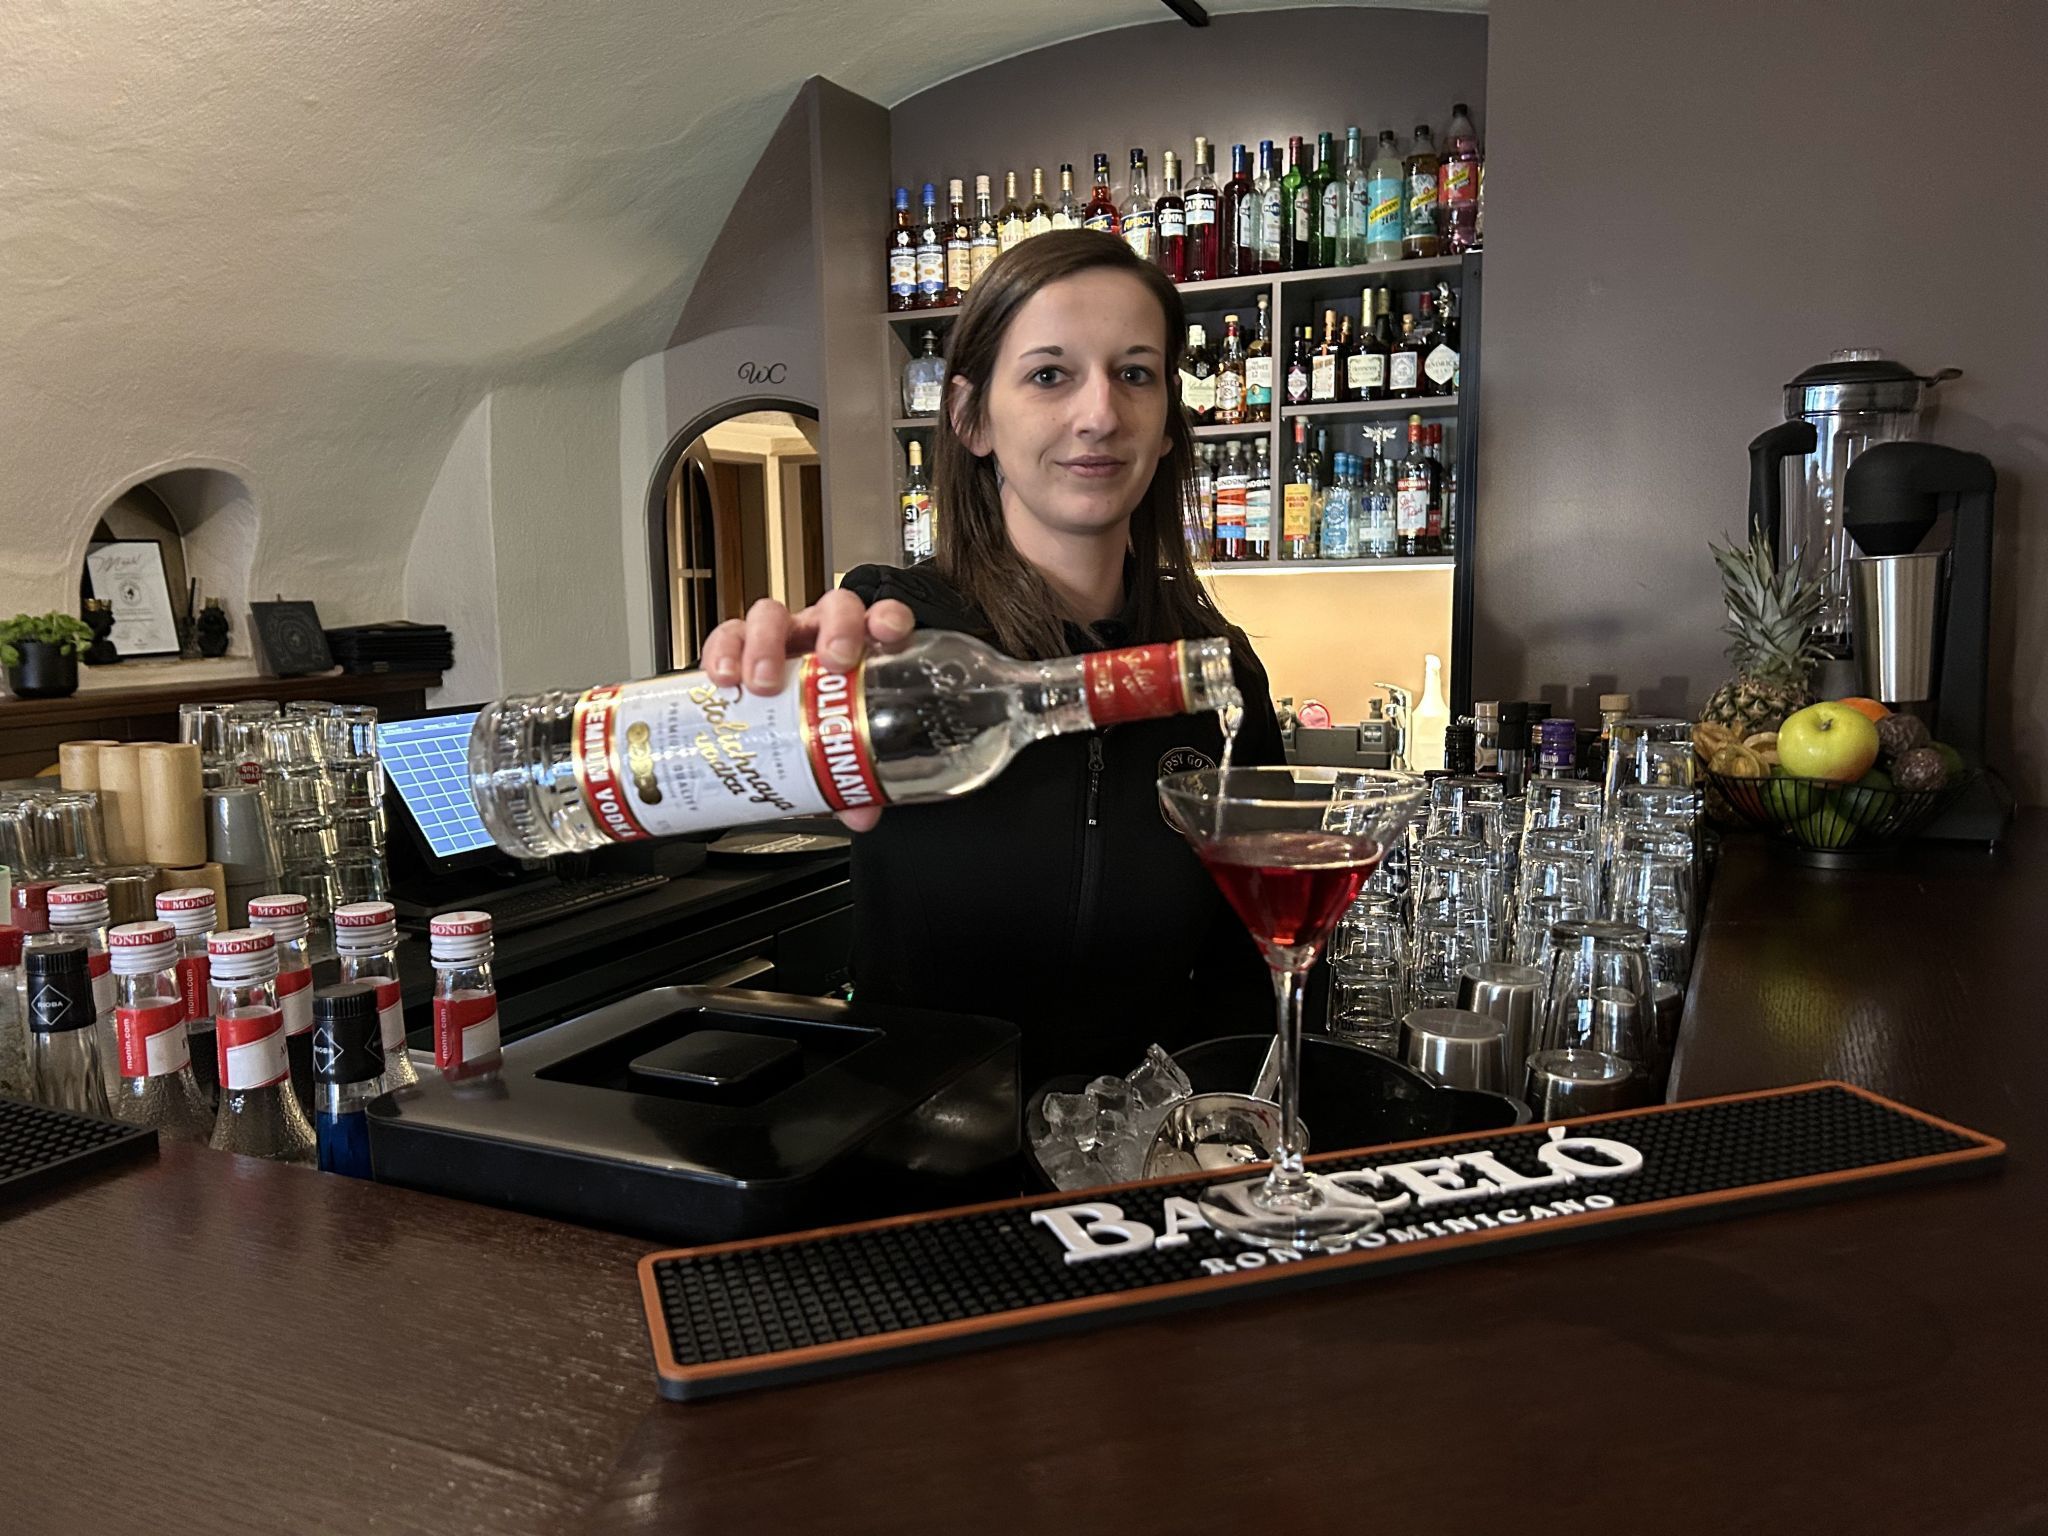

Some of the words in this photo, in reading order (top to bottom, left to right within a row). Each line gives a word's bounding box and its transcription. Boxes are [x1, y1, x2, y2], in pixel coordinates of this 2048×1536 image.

[738, 362, 787, 384] WC
[905, 508, 918, 520] 51
[817, 667, 873, 806] OLICHNAYA
[1162, 753, 1184, 775] IPSY
[595, 787, 638, 838] VODKA
[60, 890, 107, 903] MONIN
[172, 895, 214, 909] MONIN
[257, 904, 304, 916] MONIN
[215, 938, 270, 953] MONIN
[37, 1001, 63, 1009] RIOBA
[441, 1008, 449, 1059] monin.com
[124, 1018, 134, 1069] monin.com
